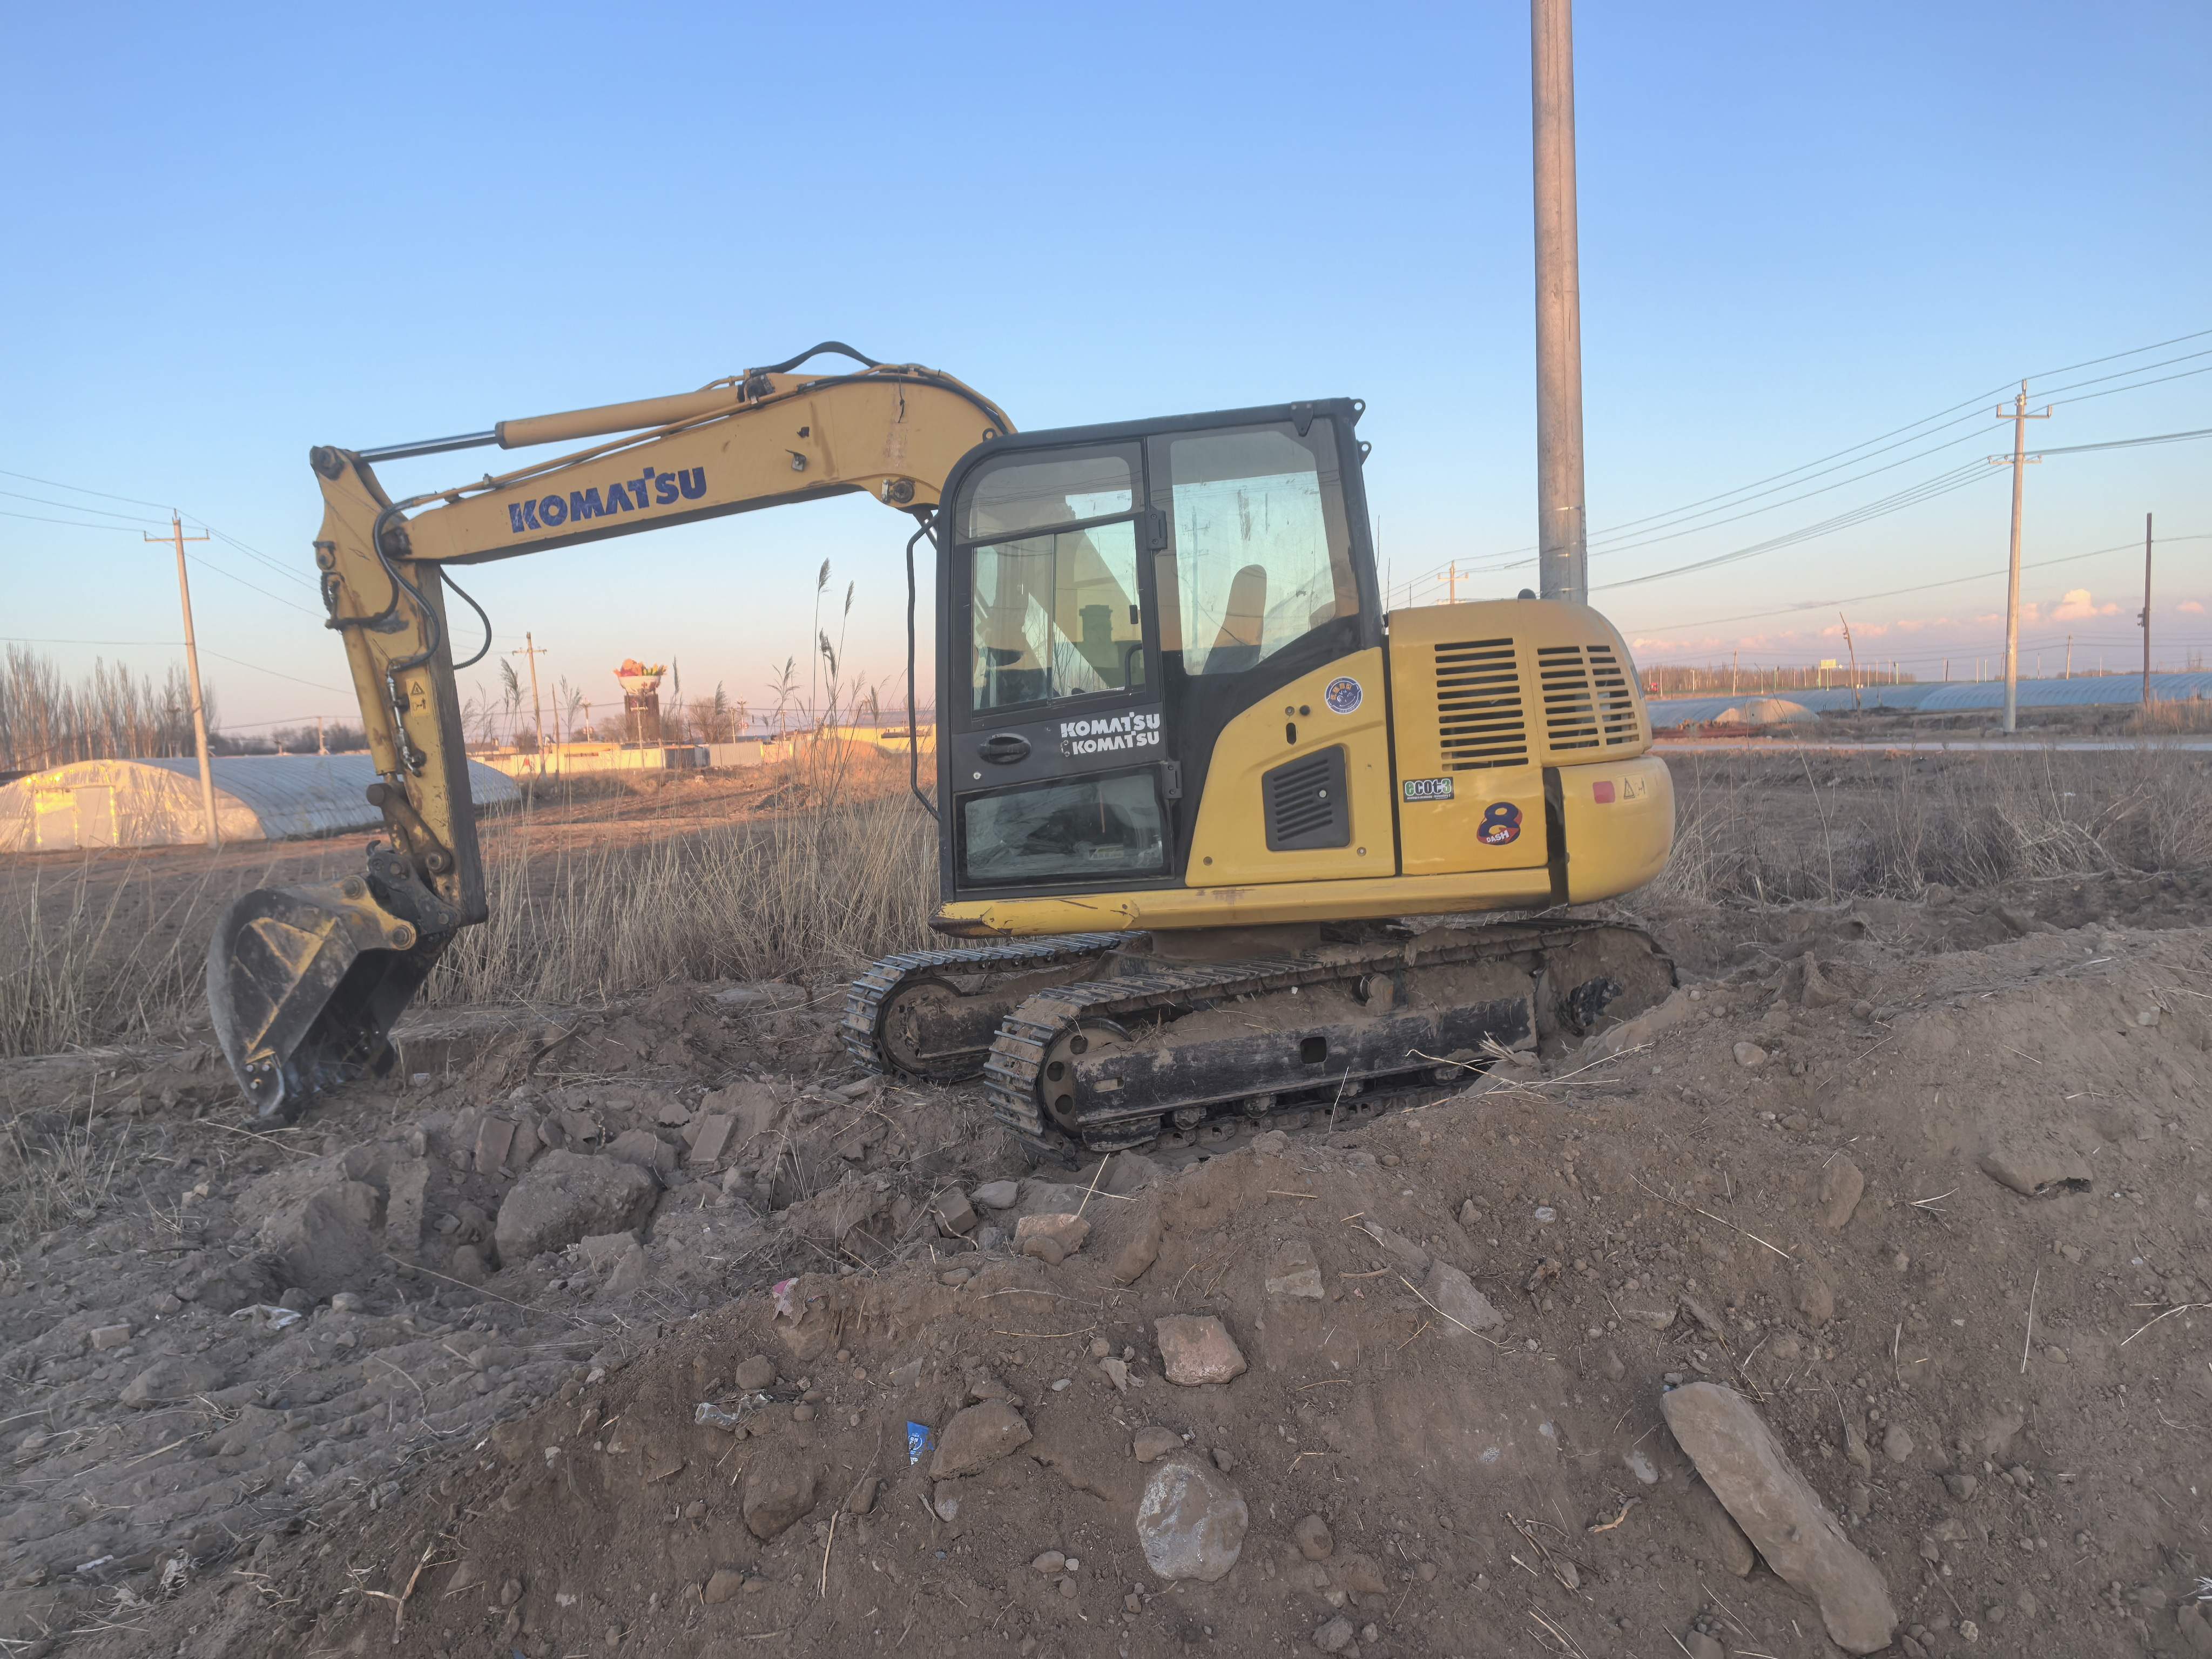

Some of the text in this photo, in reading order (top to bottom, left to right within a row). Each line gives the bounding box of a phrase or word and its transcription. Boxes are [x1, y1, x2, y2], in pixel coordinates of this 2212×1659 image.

[508, 467, 707, 533] KOMATSU
[1061, 712, 1160, 738] KOMATSU
[1073, 731, 1159, 755] KOMATSU
[1477, 802, 1522, 845] 8
[1486, 830, 1510, 842] DASH
